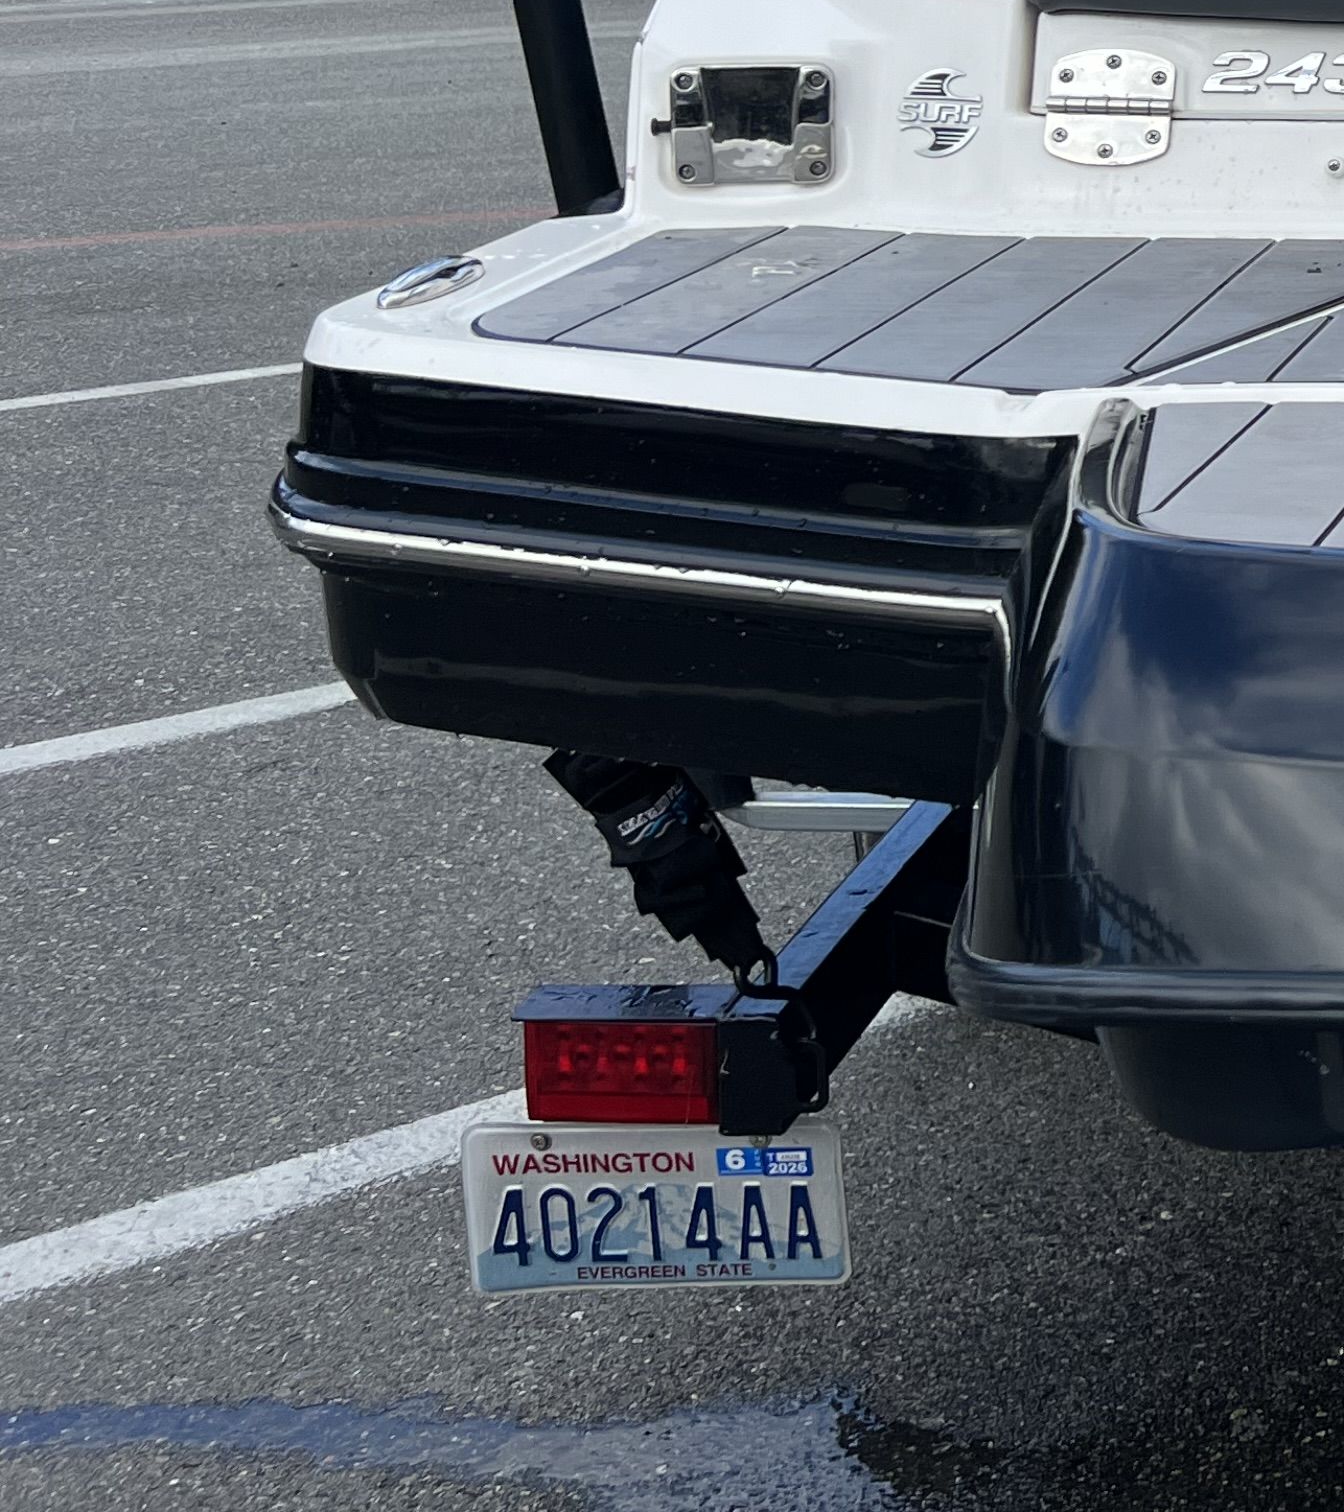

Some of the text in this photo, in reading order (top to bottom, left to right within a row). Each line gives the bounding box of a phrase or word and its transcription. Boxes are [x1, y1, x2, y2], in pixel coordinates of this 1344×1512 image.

[897, 101, 984, 124] SURF
[492, 1152, 695, 1176] WASHINGTON
[725, 1149, 746, 1170] 6
[768, 1161, 808, 1174] 2026
[492, 1184, 824, 1267] 40214AA
[577, 1262, 753, 1281] EVERGREEN STATE
